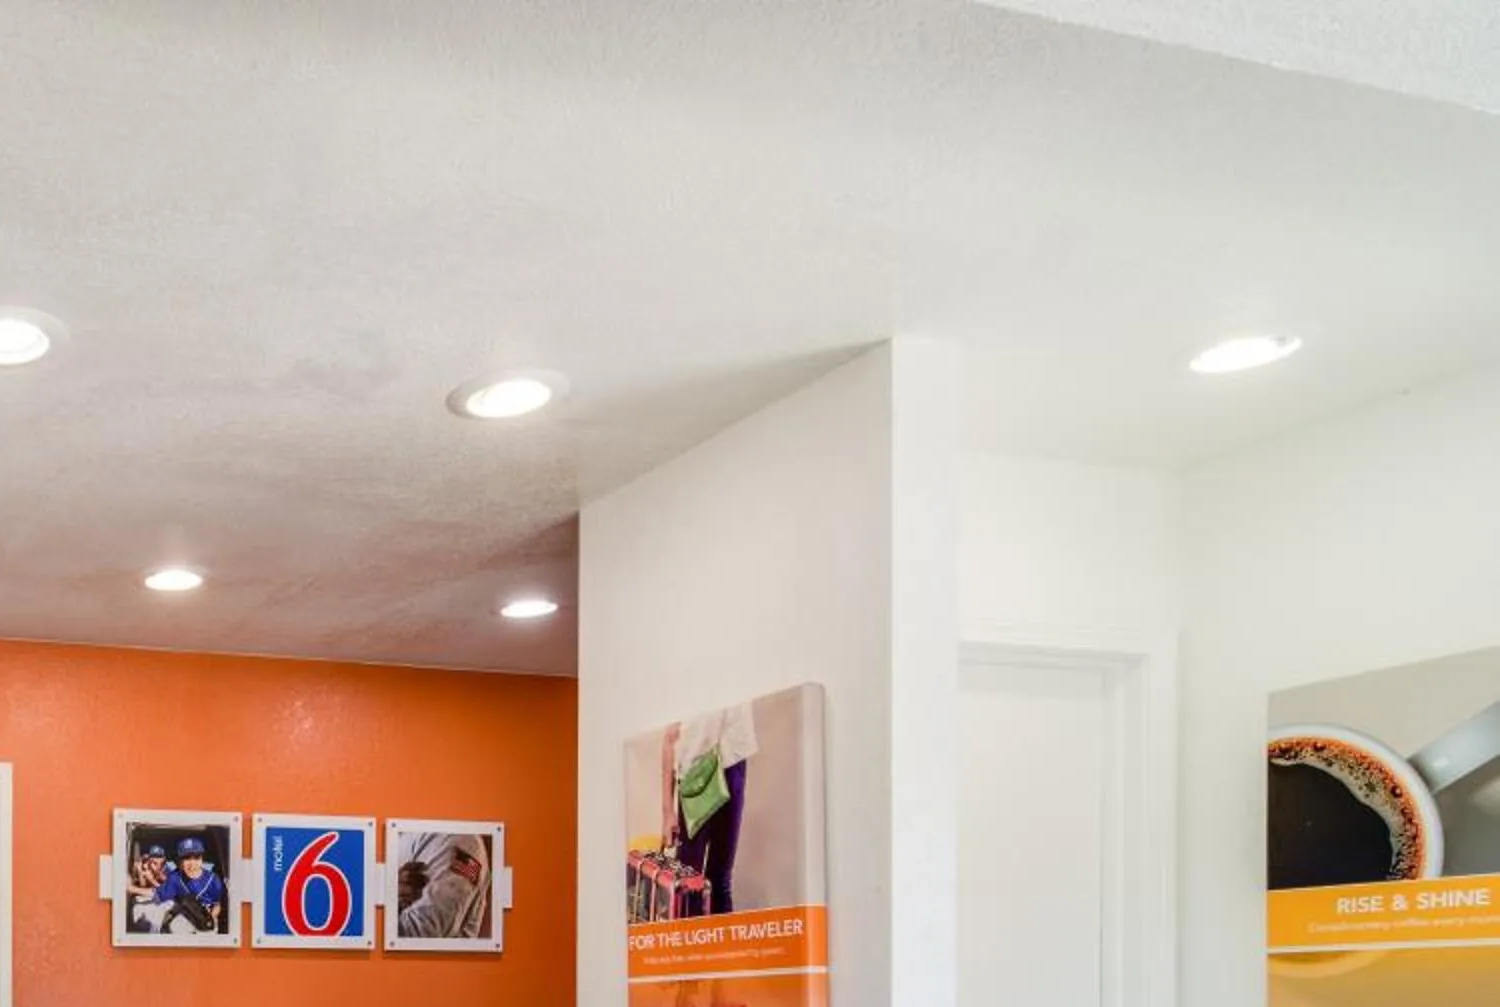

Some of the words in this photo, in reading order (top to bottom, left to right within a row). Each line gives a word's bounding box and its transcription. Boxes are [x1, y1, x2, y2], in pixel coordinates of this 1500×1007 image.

[281, 830, 353, 937] 6
[1336, 895, 1385, 914] RISE
[1392, 893, 1408, 911] &
[1416, 888, 1492, 911] SHINE
[629, 934, 656, 951] FOR
[658, 931, 683, 948] THE
[685, 926, 725, 945] LIGHT
[730, 919, 803, 940] TRAVELER
